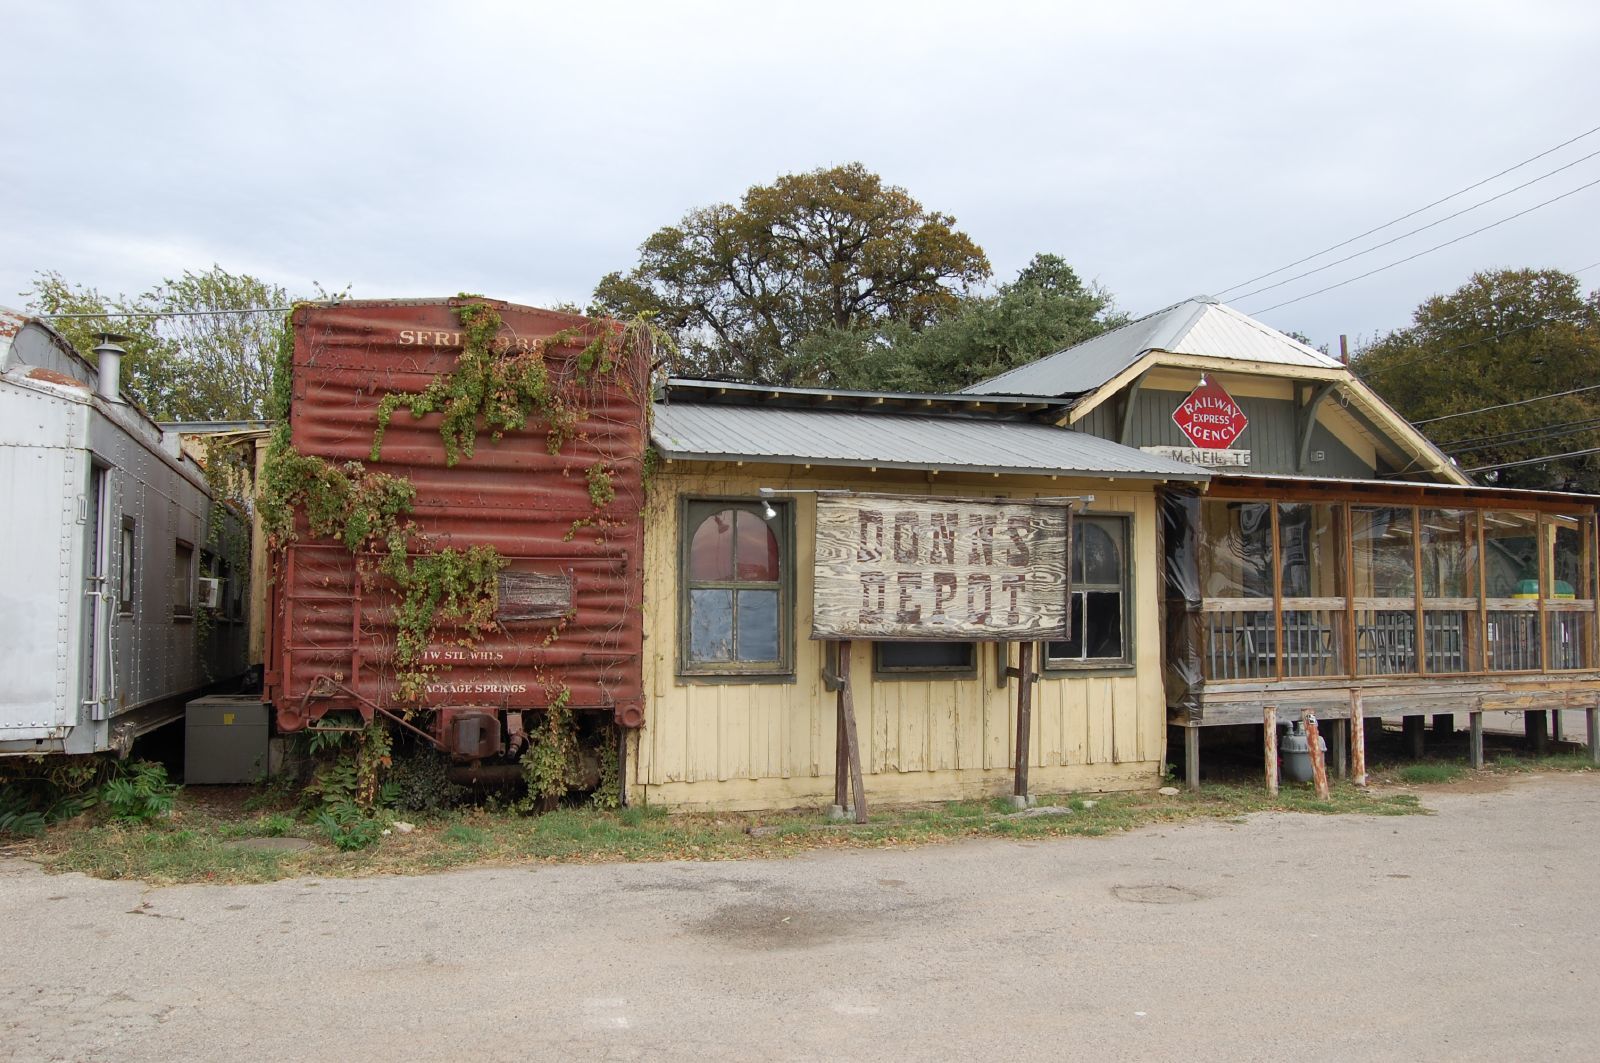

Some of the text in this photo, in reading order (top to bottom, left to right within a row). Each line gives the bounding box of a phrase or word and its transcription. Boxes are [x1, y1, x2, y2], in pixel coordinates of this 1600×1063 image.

[1183, 397, 1240, 419] RAILWAY
[1193, 413, 1230, 425] EXPRESS
[1183, 421, 1236, 441] AGENCY
[859, 571, 1026, 625] DEPOT
[444, 651, 466, 660] STL
[425, 684, 527, 693] ACKAGE SPRINGS
